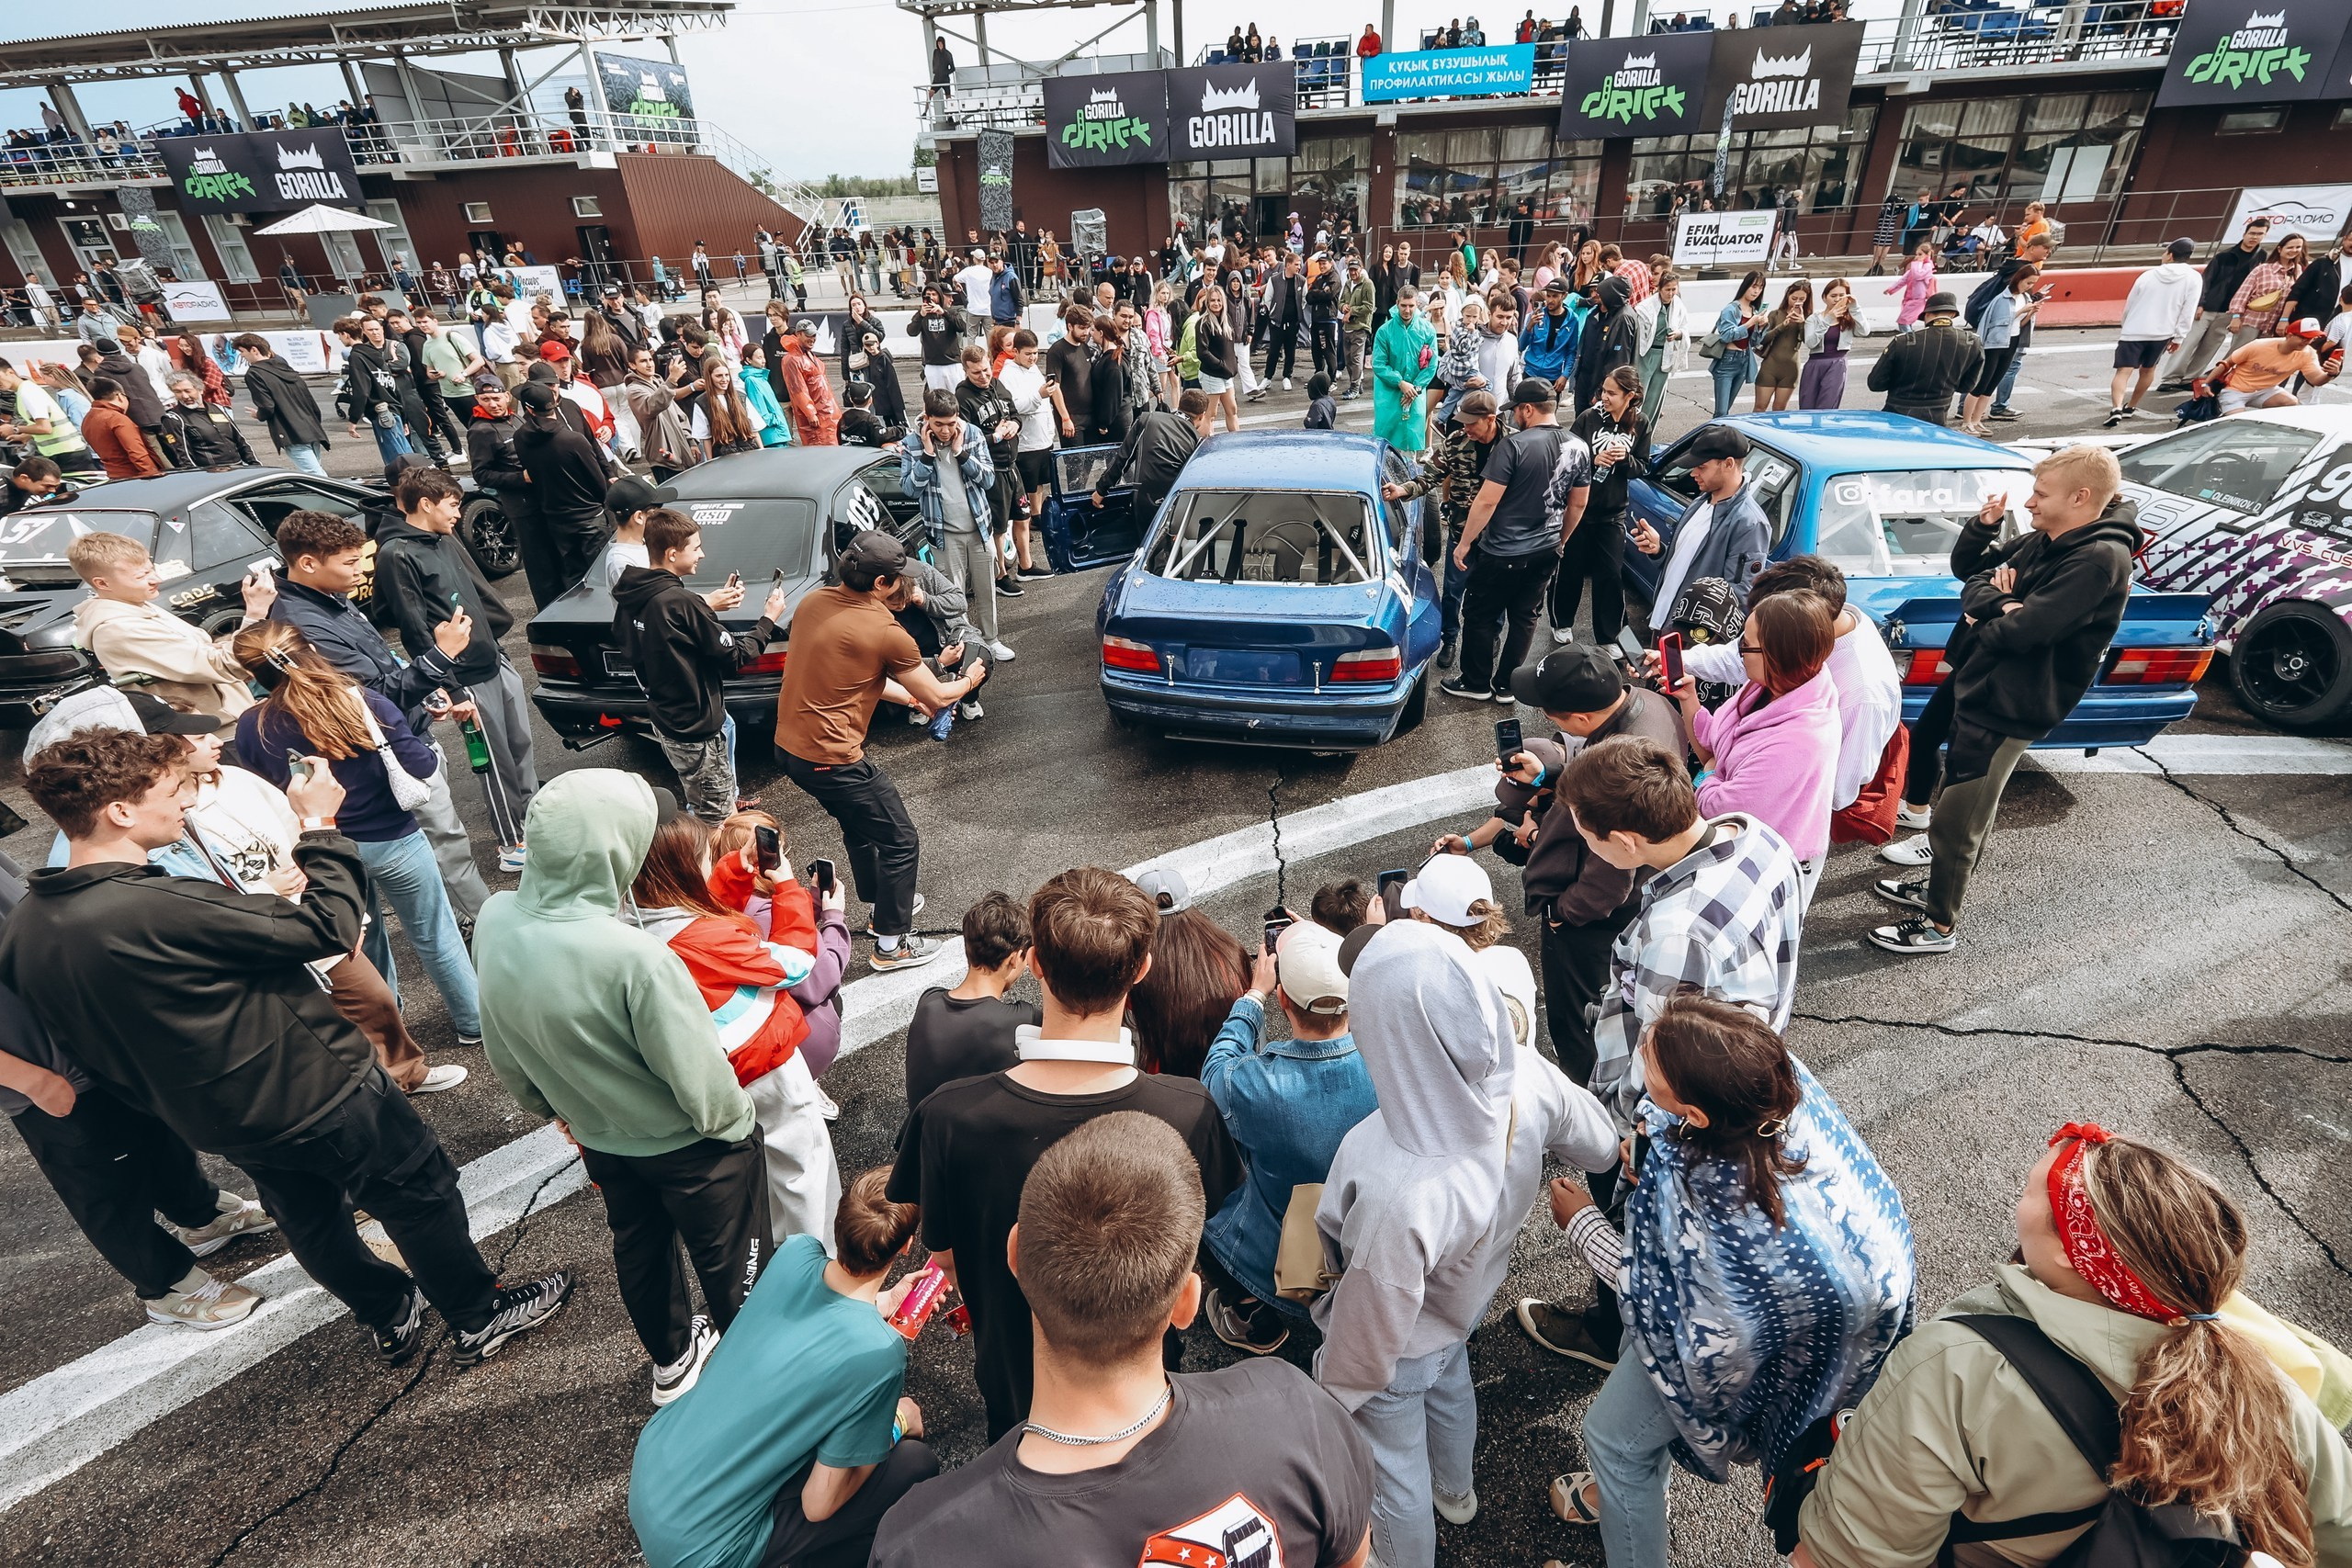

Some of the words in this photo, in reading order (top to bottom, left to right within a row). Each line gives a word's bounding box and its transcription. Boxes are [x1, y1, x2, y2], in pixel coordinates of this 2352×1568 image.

[2229, 28, 2288, 49] GORILLA
[1388, 59, 1430, 73] ҚҰҚЫҚ
[1432, 53, 1509, 71] БҰЗУШЫЛЫҚ
[1370, 73, 1484, 90] ПРОФИЛАКТИКАСЫ
[1485, 70, 1525, 83] ЖЫЛЫ
[1613, 69, 1661, 87] GORILLA
[1734, 78, 1820, 115] GORILLA
[1084, 102, 1125, 119] GORILLA
[1188, 111, 1276, 148] GORILLA
[193, 159, 228, 175] GORILLA
[275, 171, 348, 200] GORILLA
[1684, 233, 1763, 246] EVACUATOR
[1687, 224, 1719, 236] EFIM
[81, 237, 105, 245] HOSTEL
[846, 486, 880, 532] 103
[0, 517, 59, 544] 57
[169, 583, 215, 605] CADS
